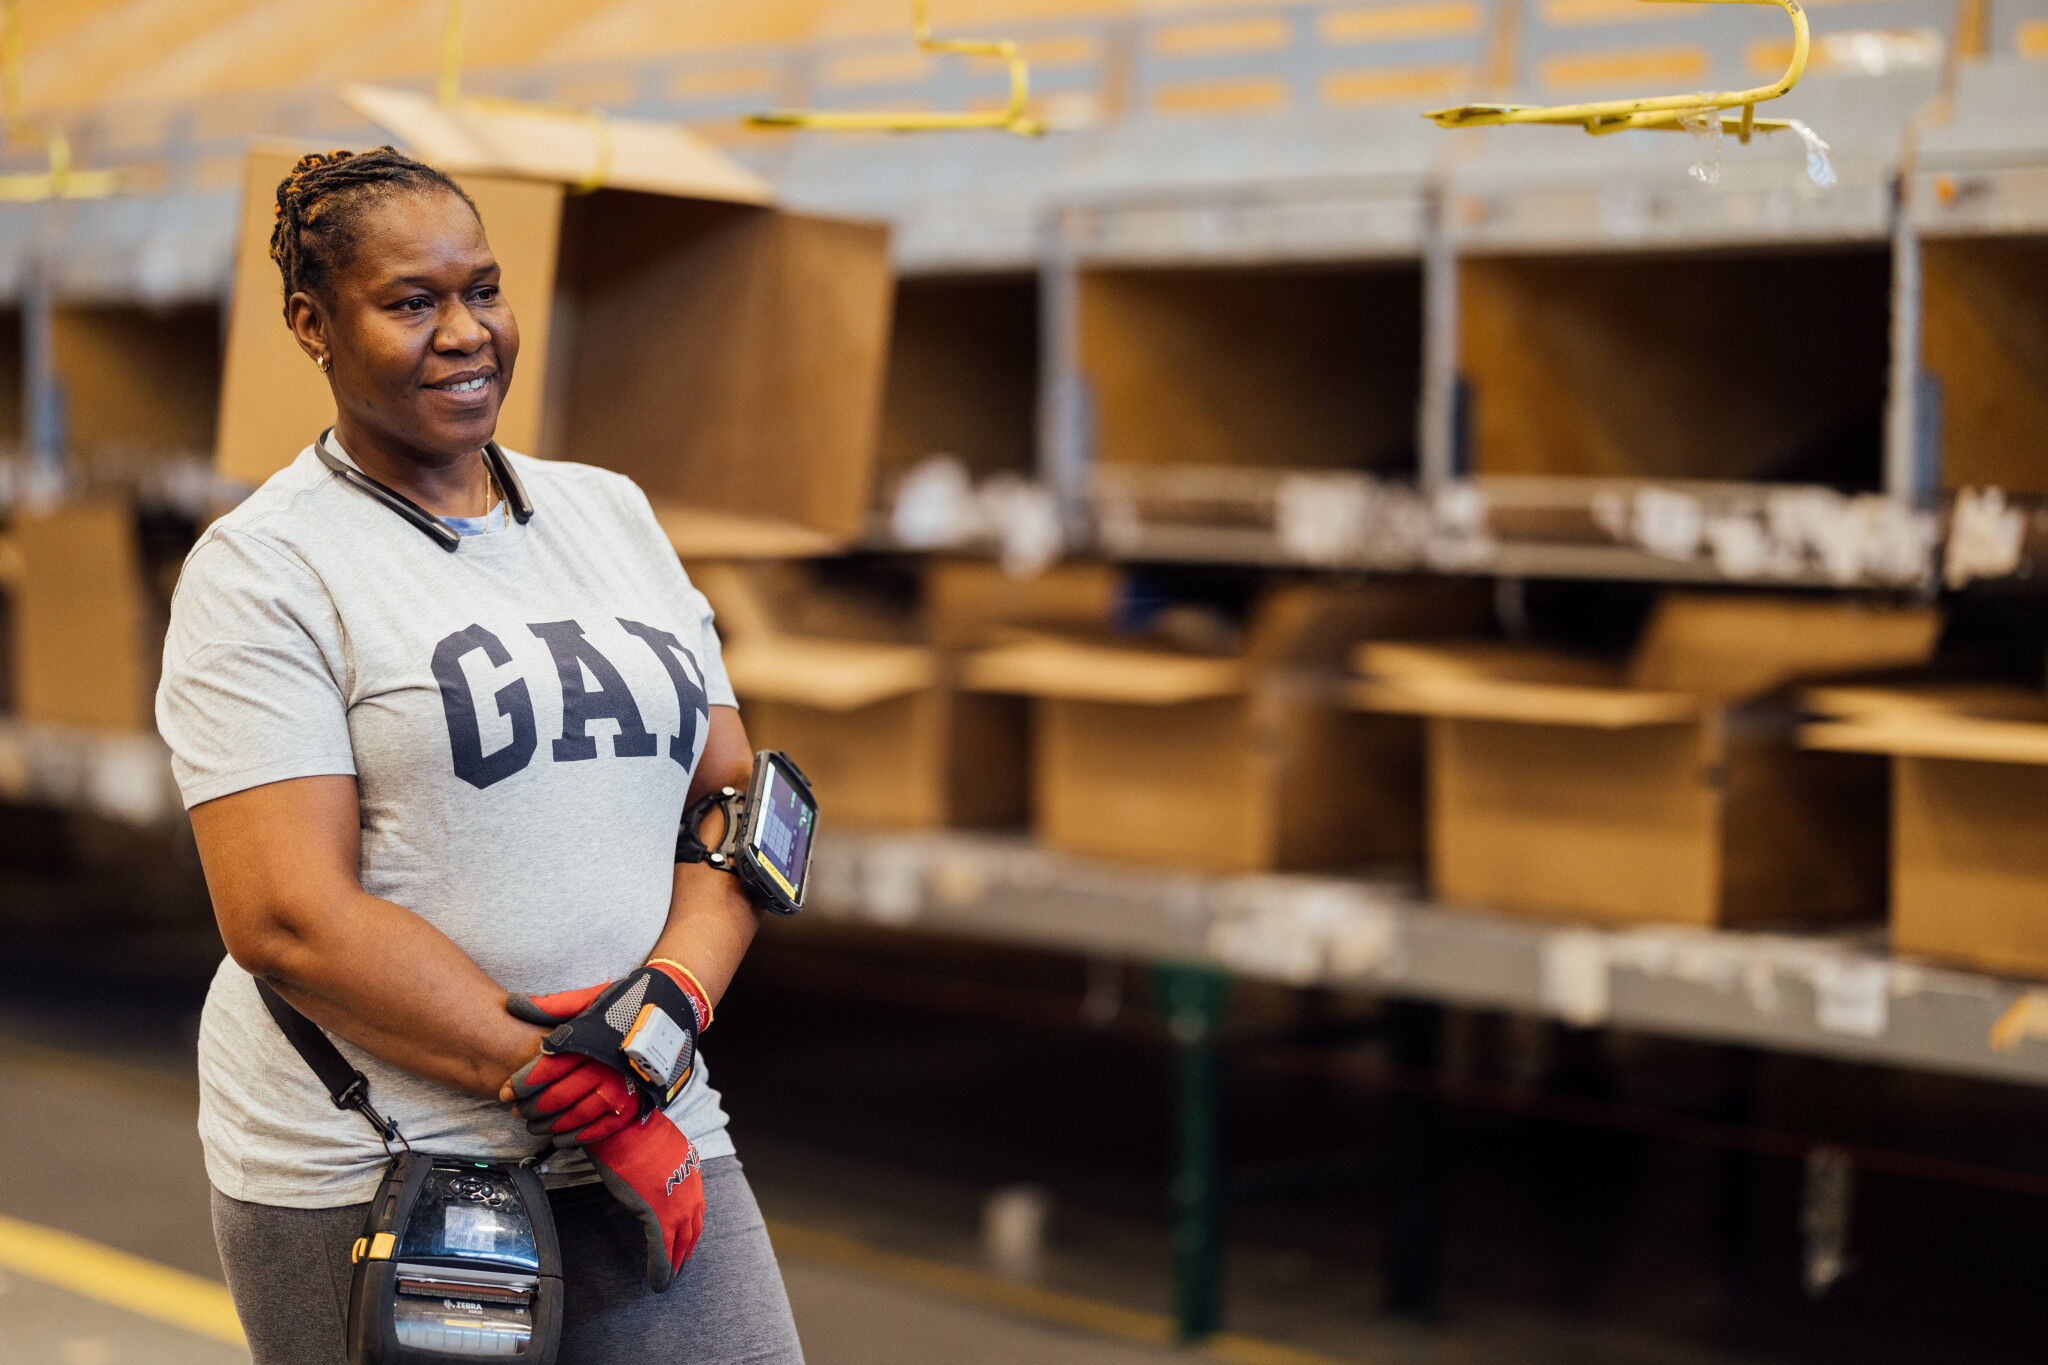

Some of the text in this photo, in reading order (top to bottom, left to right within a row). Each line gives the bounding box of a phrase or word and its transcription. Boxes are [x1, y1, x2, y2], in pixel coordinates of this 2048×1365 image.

[430, 617, 709, 789] GAP
[666, 1145, 700, 1196] NIN
[456, 1302, 482, 1310] ZEBRA
